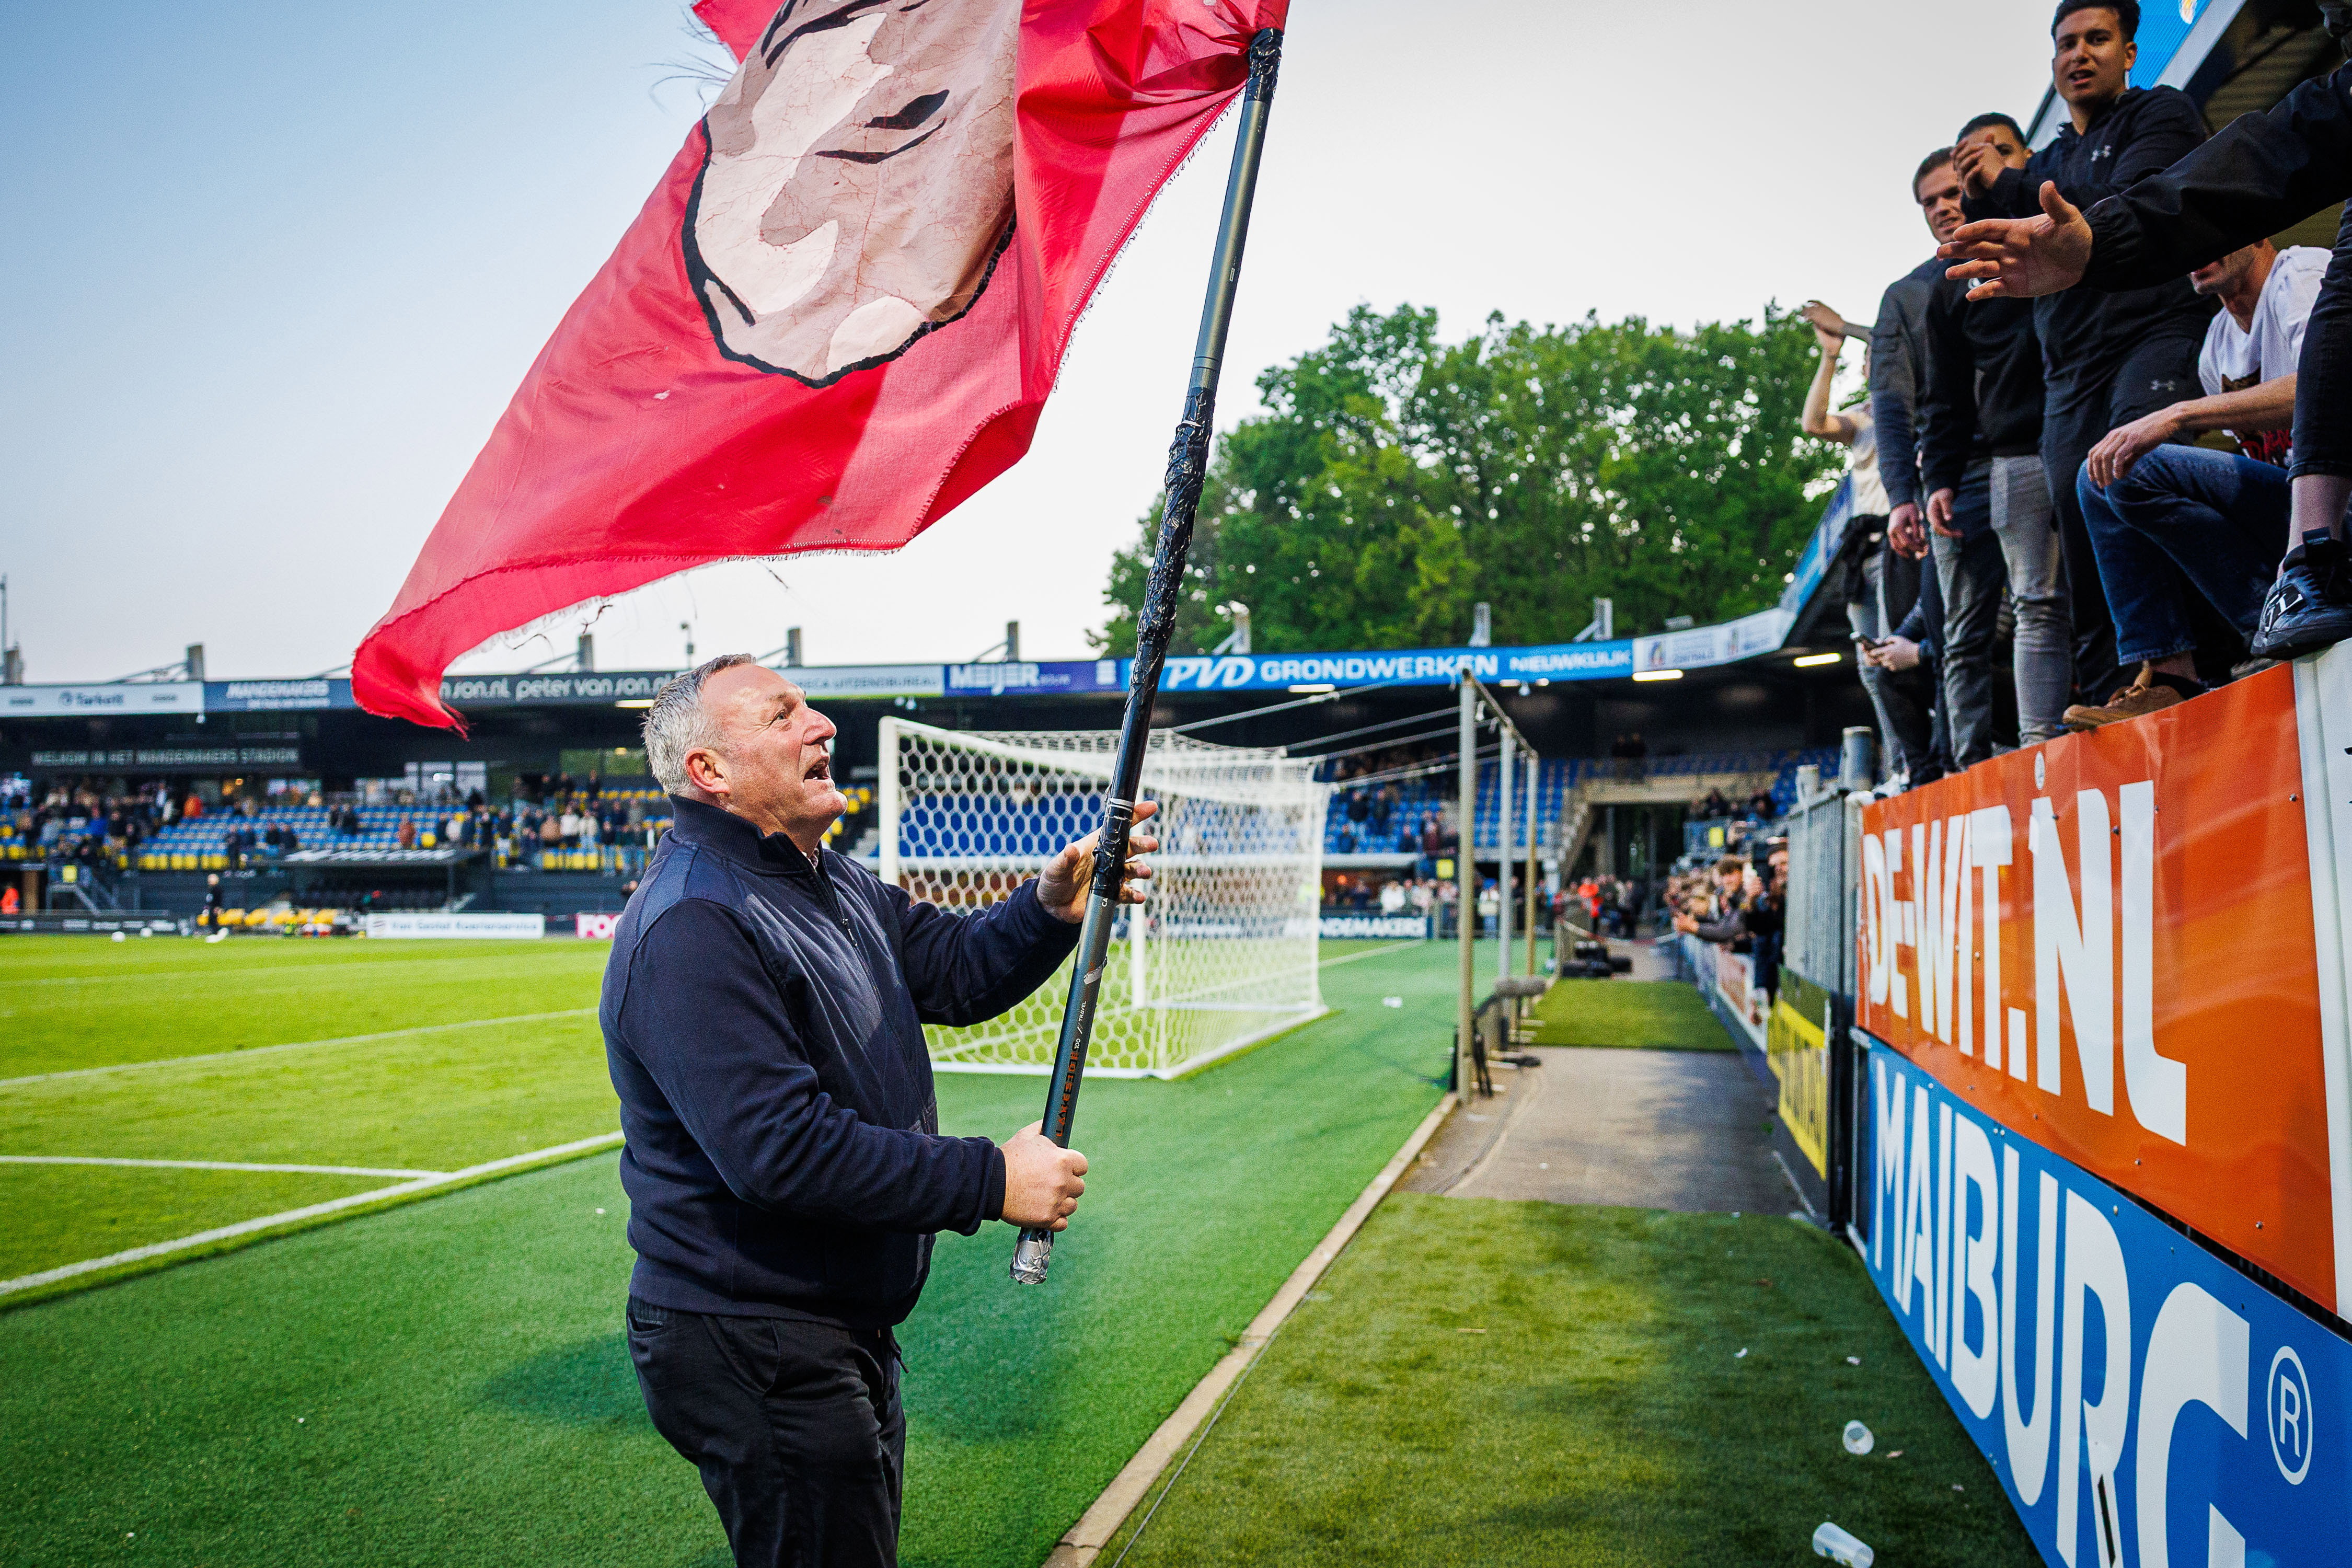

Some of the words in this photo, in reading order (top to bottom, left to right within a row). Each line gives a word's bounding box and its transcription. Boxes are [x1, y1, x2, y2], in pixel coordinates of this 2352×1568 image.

[1260, 654, 1498, 682] GRONDWERKEN
[515, 677, 571, 702] peter
[575, 678, 614, 696] van
[1078, 1000, 1087, 1022] TRAVEL
